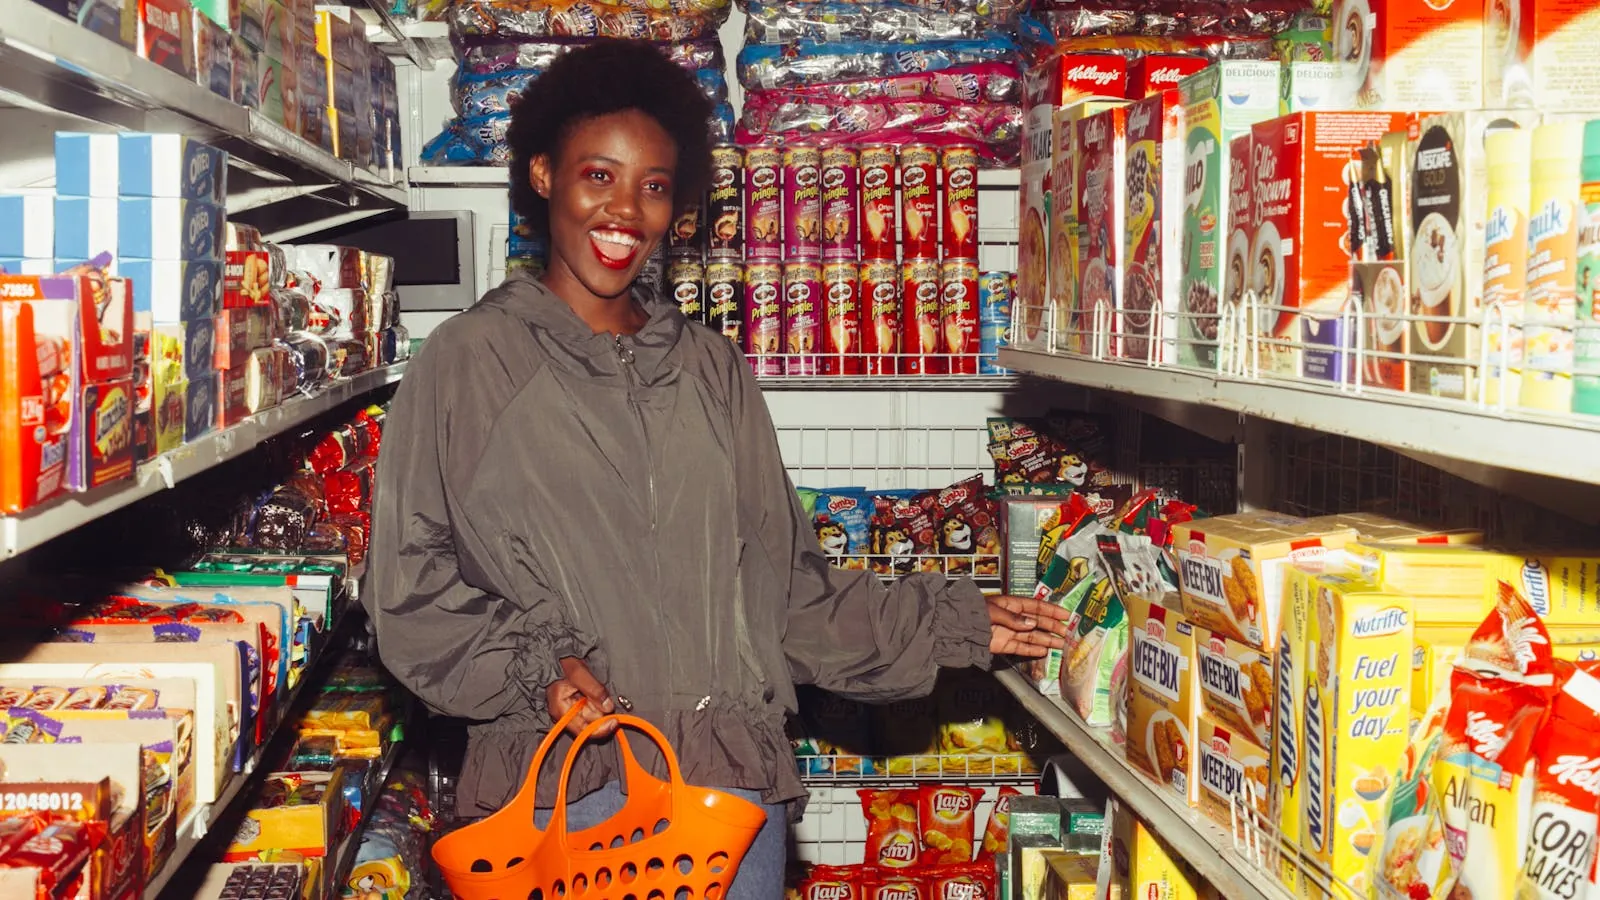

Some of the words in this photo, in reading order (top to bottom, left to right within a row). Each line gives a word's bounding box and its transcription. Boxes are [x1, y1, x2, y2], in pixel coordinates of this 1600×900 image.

[1067, 64, 1120, 85] Kellogg's
[1150, 68, 1188, 84] Kello
[1225, 69, 1276, 78] DELICIOUS
[795, 186, 819, 204] Pringle
[863, 186, 891, 207] Pringles
[948, 187, 976, 208] Pringles
[679, 300, 701, 313] ringles
[710, 302, 738, 321] Pringles
[787, 302, 814, 320] Pringles
[1009, 442, 1035, 457] Simba
[828, 498, 857, 512] Simba
[939, 488, 966, 506] Simba
[1181, 556, 1224, 600] WEET-BIX
[1525, 558, 1546, 616] Nutrific
[1352, 609, 1408, 635] Nutrific
[1134, 636, 1179, 693] WEET-BIX
[1353, 655, 1398, 681] Fuel
[1200, 653, 1241, 703] WEET-BIX
[1351, 687, 1401, 714] your
[1278, 636, 1294, 798] Nutrific
[1351, 715, 1402, 740] day...
[1306, 672, 1321, 851] Nutrific
[1201, 749, 1244, 799] WEET-BIX
[936, 796, 970, 818] Lay's
[1525, 845, 1583, 900] FLAKES
[811, 884, 850, 900] Lay's
